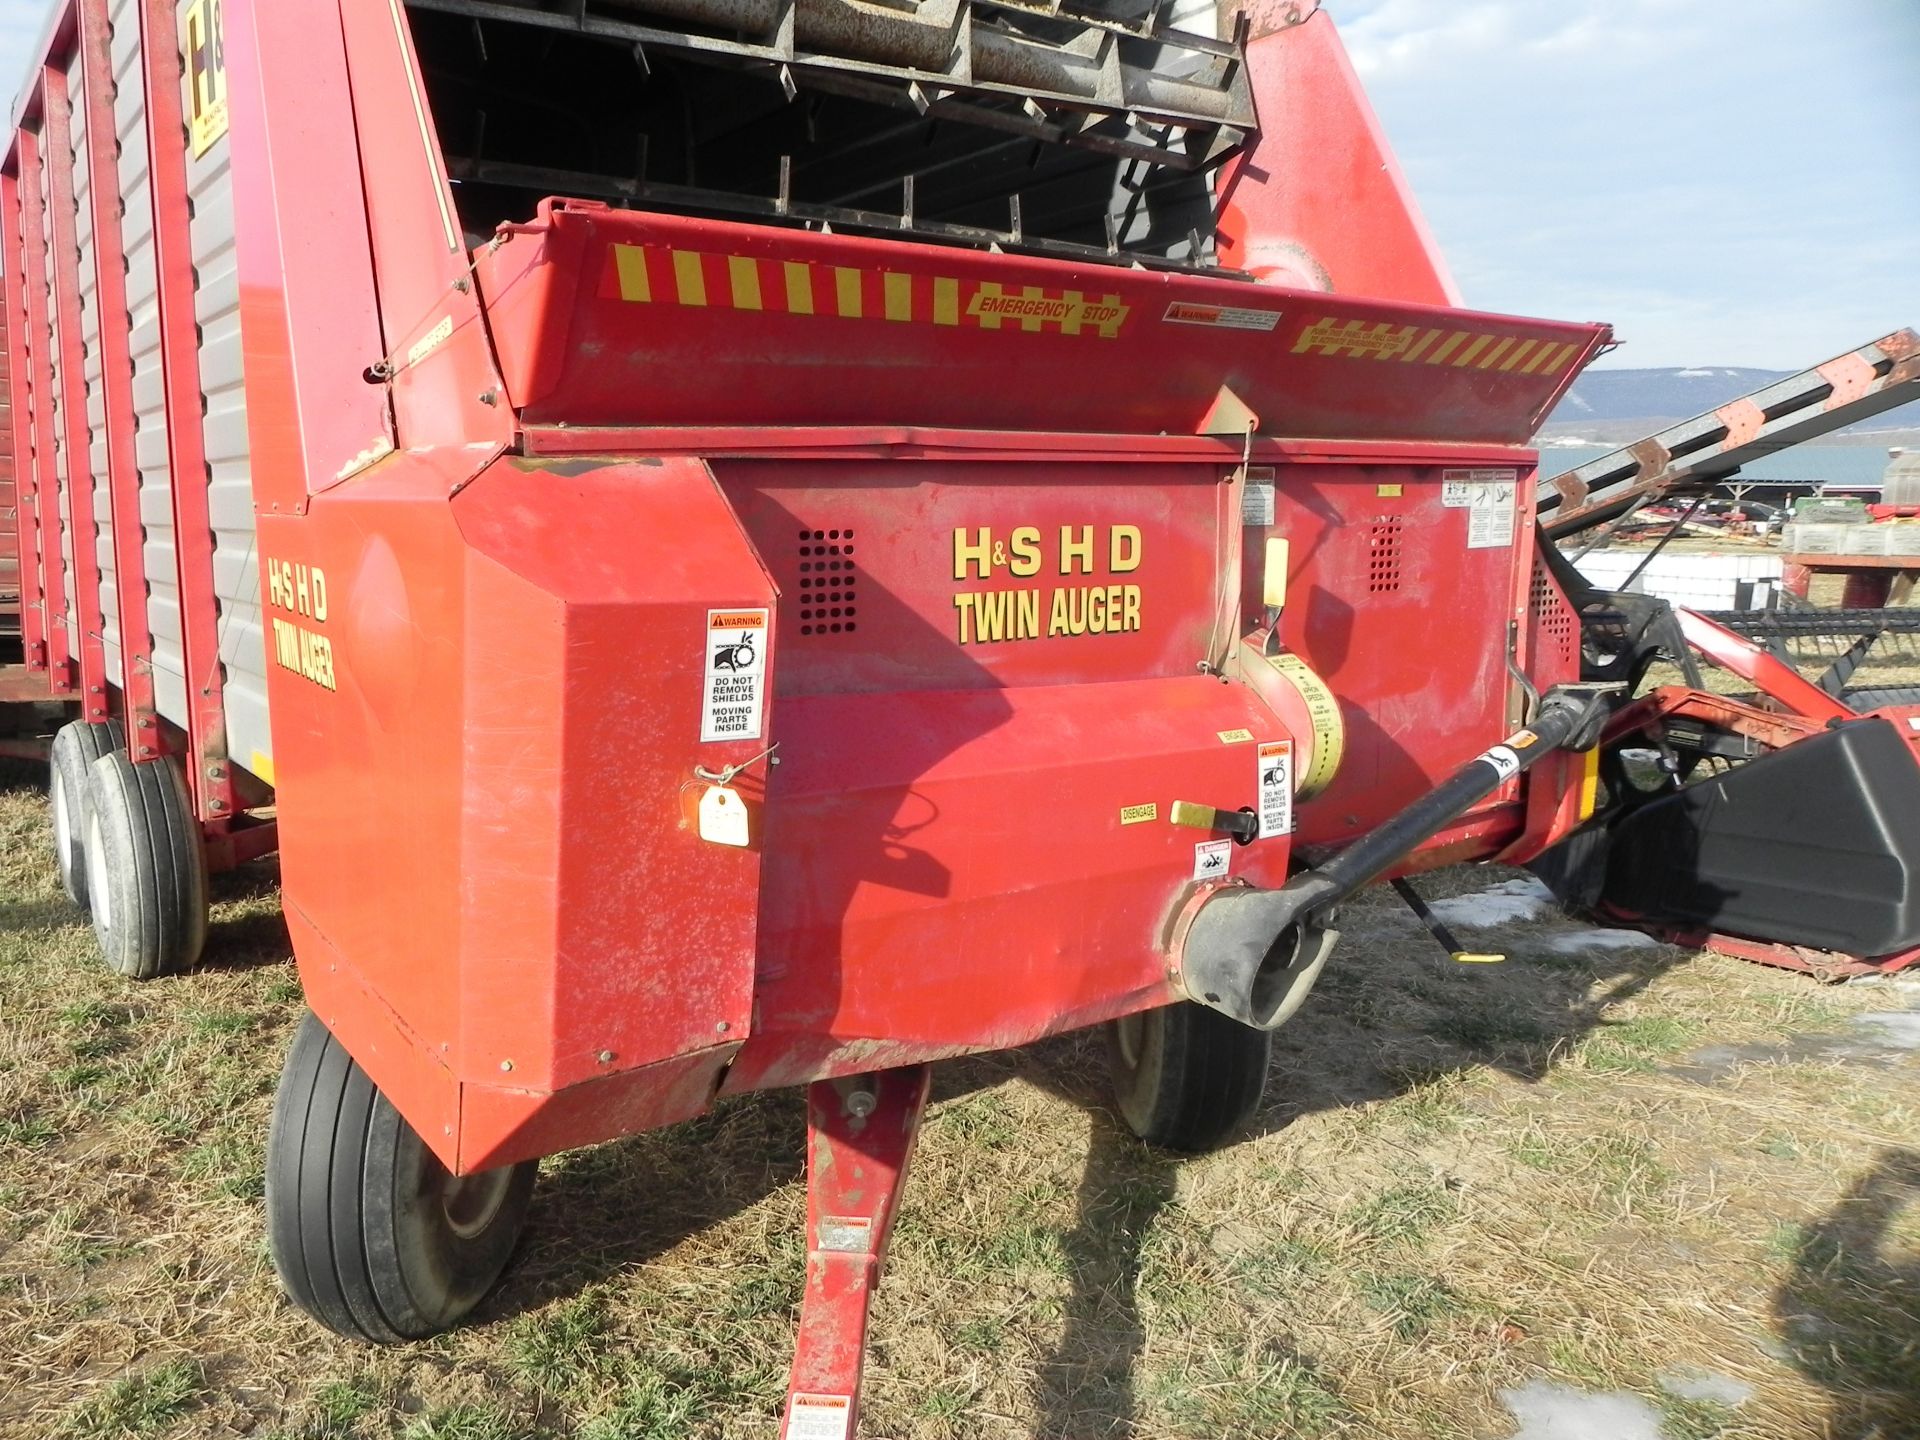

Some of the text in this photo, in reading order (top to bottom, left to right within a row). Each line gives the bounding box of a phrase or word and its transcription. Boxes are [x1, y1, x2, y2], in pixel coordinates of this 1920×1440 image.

[979, 297, 1119, 322] EMERGENCY STOP
[953, 525, 1142, 581] H&S H D
[953, 585, 1142, 645] TWIN AUGER
[723, 616, 762, 627] WARNING
[272, 617, 337, 693] TWIN AUGER
[715, 676, 753, 686] DO NOT
[713, 685, 754, 695] REMOVE
[712, 693, 754, 703] SHIELDS
[712, 706, 752, 716] MOVING
[716, 715, 748, 724] PARTS
[714, 723, 748, 733] INSIDE
[1273, 789, 1285, 797] NOT
[1263, 795, 1286, 804] REMOVE
[1263, 802, 1287, 811] SHIELDS
[1123, 805, 1155, 821] DISENGAGE
[1264, 810, 1286, 819] MOVING
[1266, 817, 1284, 825] PARTS
[1266, 822, 1284, 832] INSIDE
[808, 1399, 845, 1408] WARNING
